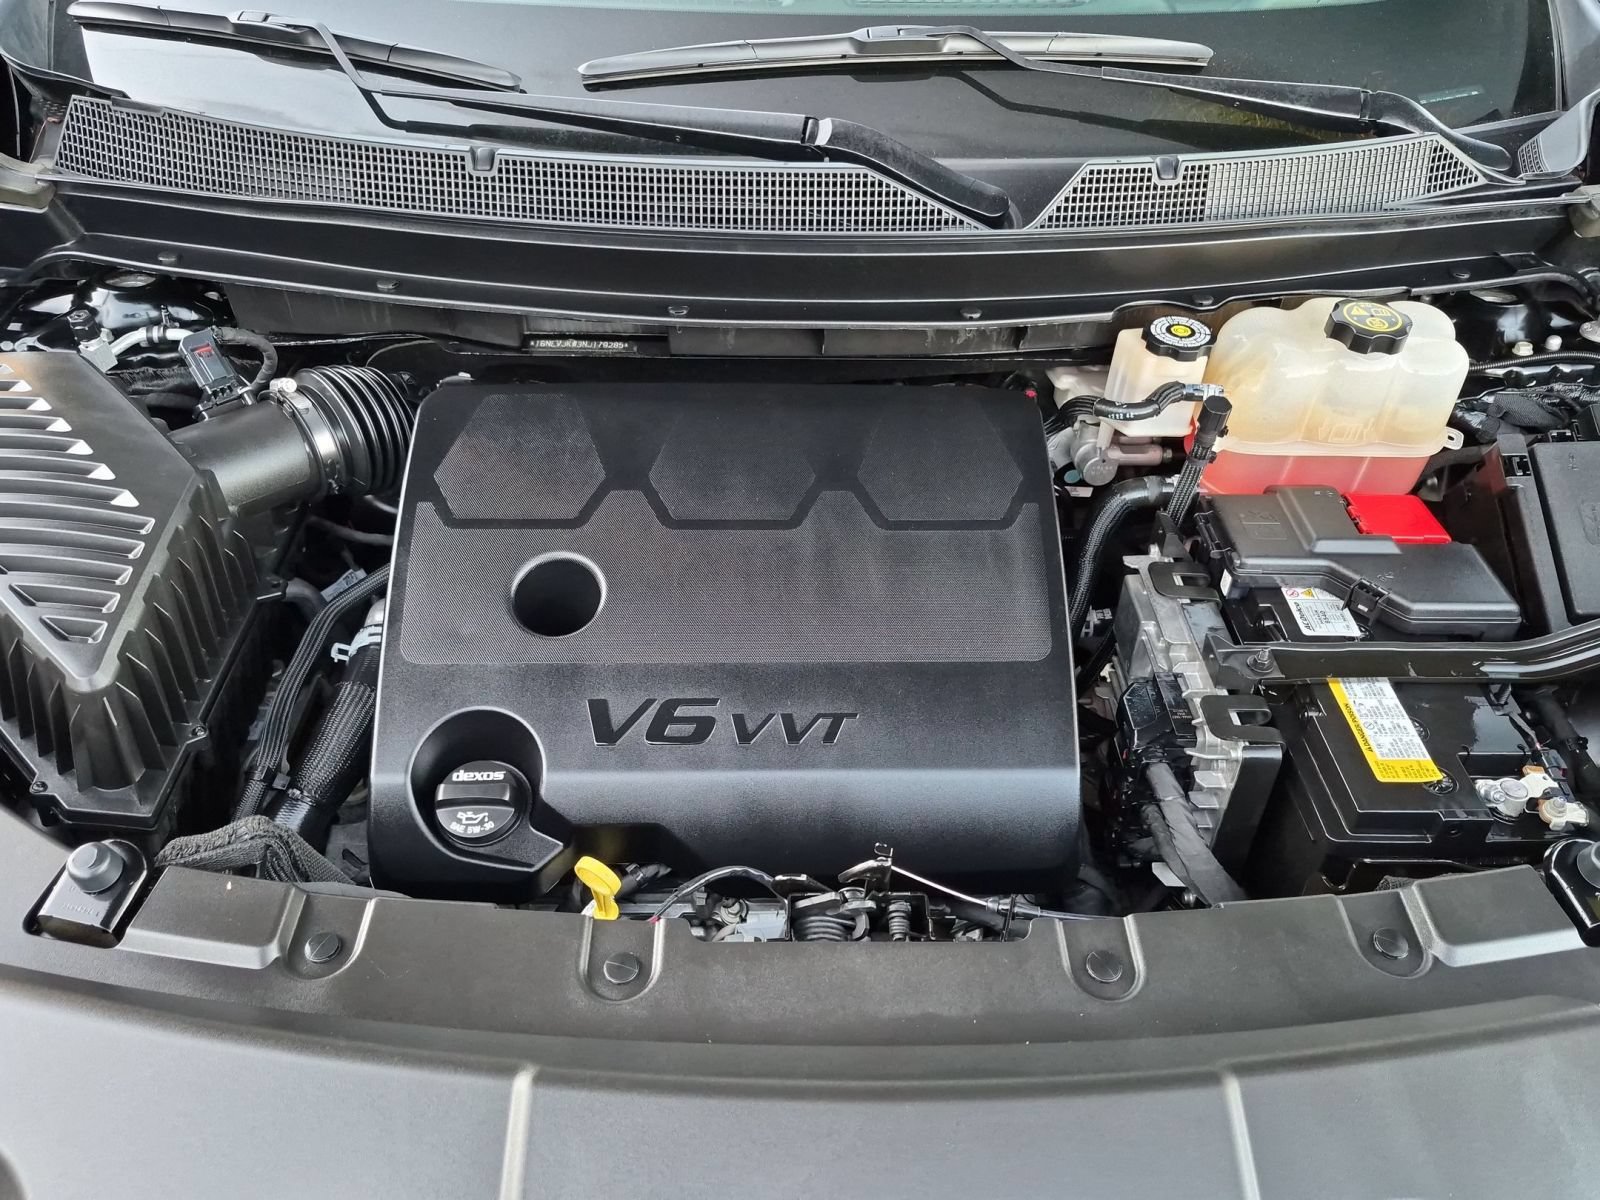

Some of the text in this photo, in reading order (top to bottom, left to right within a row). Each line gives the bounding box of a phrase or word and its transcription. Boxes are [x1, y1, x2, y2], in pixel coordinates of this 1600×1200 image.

[1294, 602, 1312, 631] ACDelco
[587, 698, 859, 746] V6 VVT
[452, 770, 506, 781] dexos
[450, 821, 495, 834] SAE 5W-30
